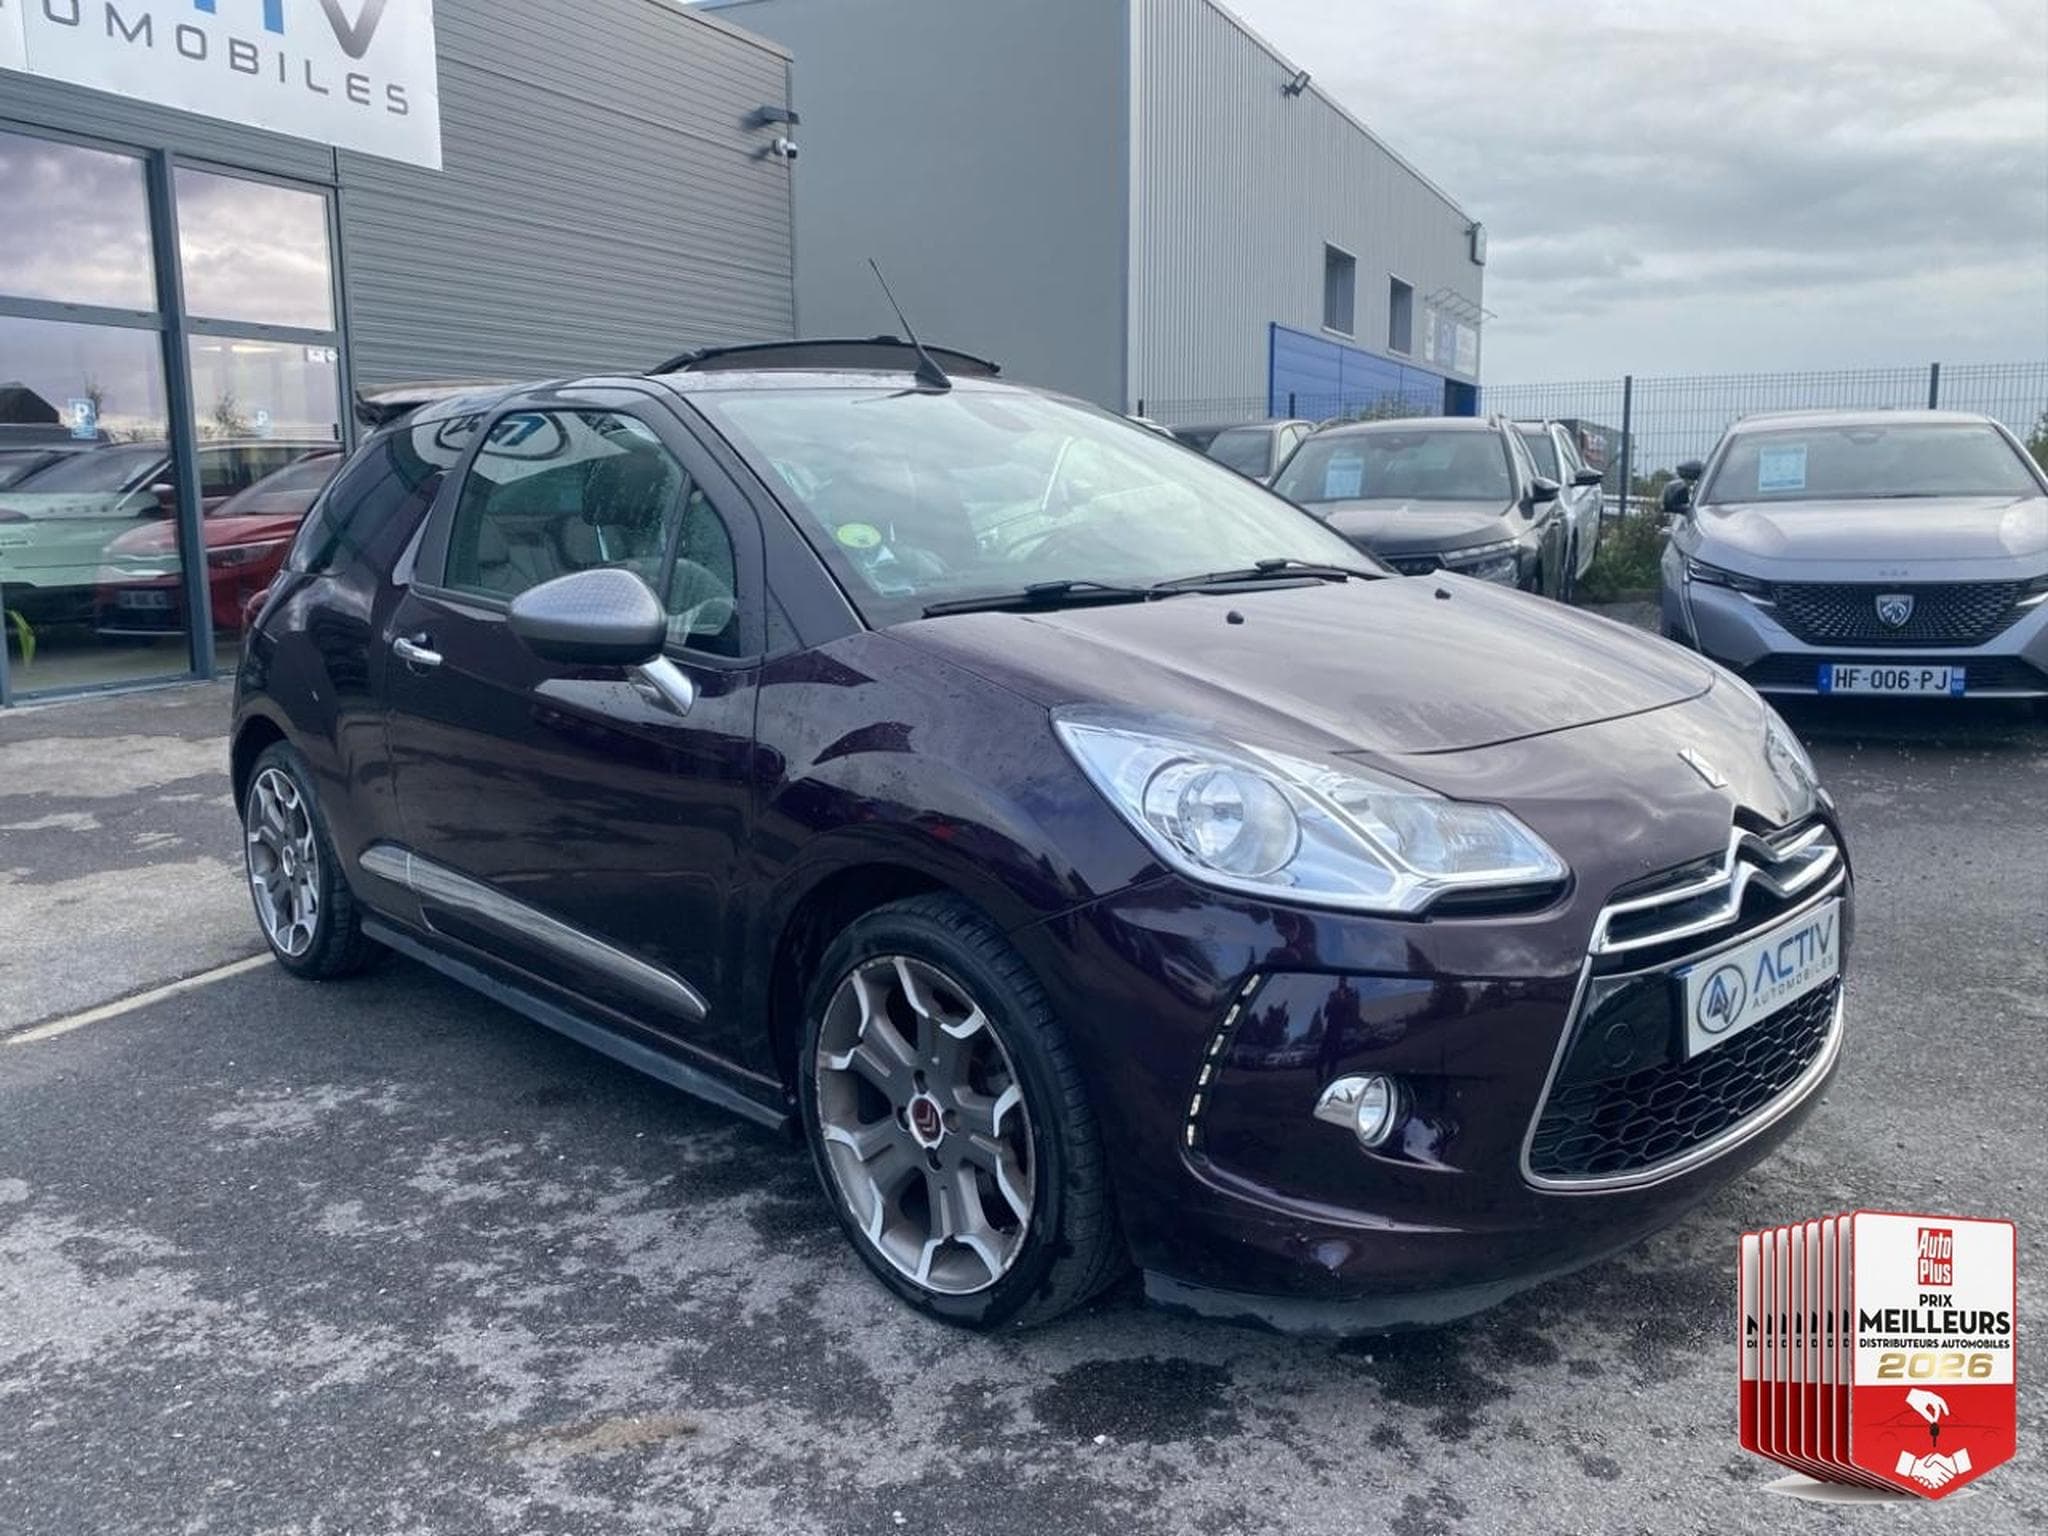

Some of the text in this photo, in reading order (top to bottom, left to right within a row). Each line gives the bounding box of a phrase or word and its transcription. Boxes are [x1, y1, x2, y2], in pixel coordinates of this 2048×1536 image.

[0, 0, 410, 117] OMOBILES
[1834, 667, 1948, 691] HF-006-PJ
[1751, 953, 1835, 1009] AUTOMOBILES
[1754, 913, 1834, 994] ACTIV
